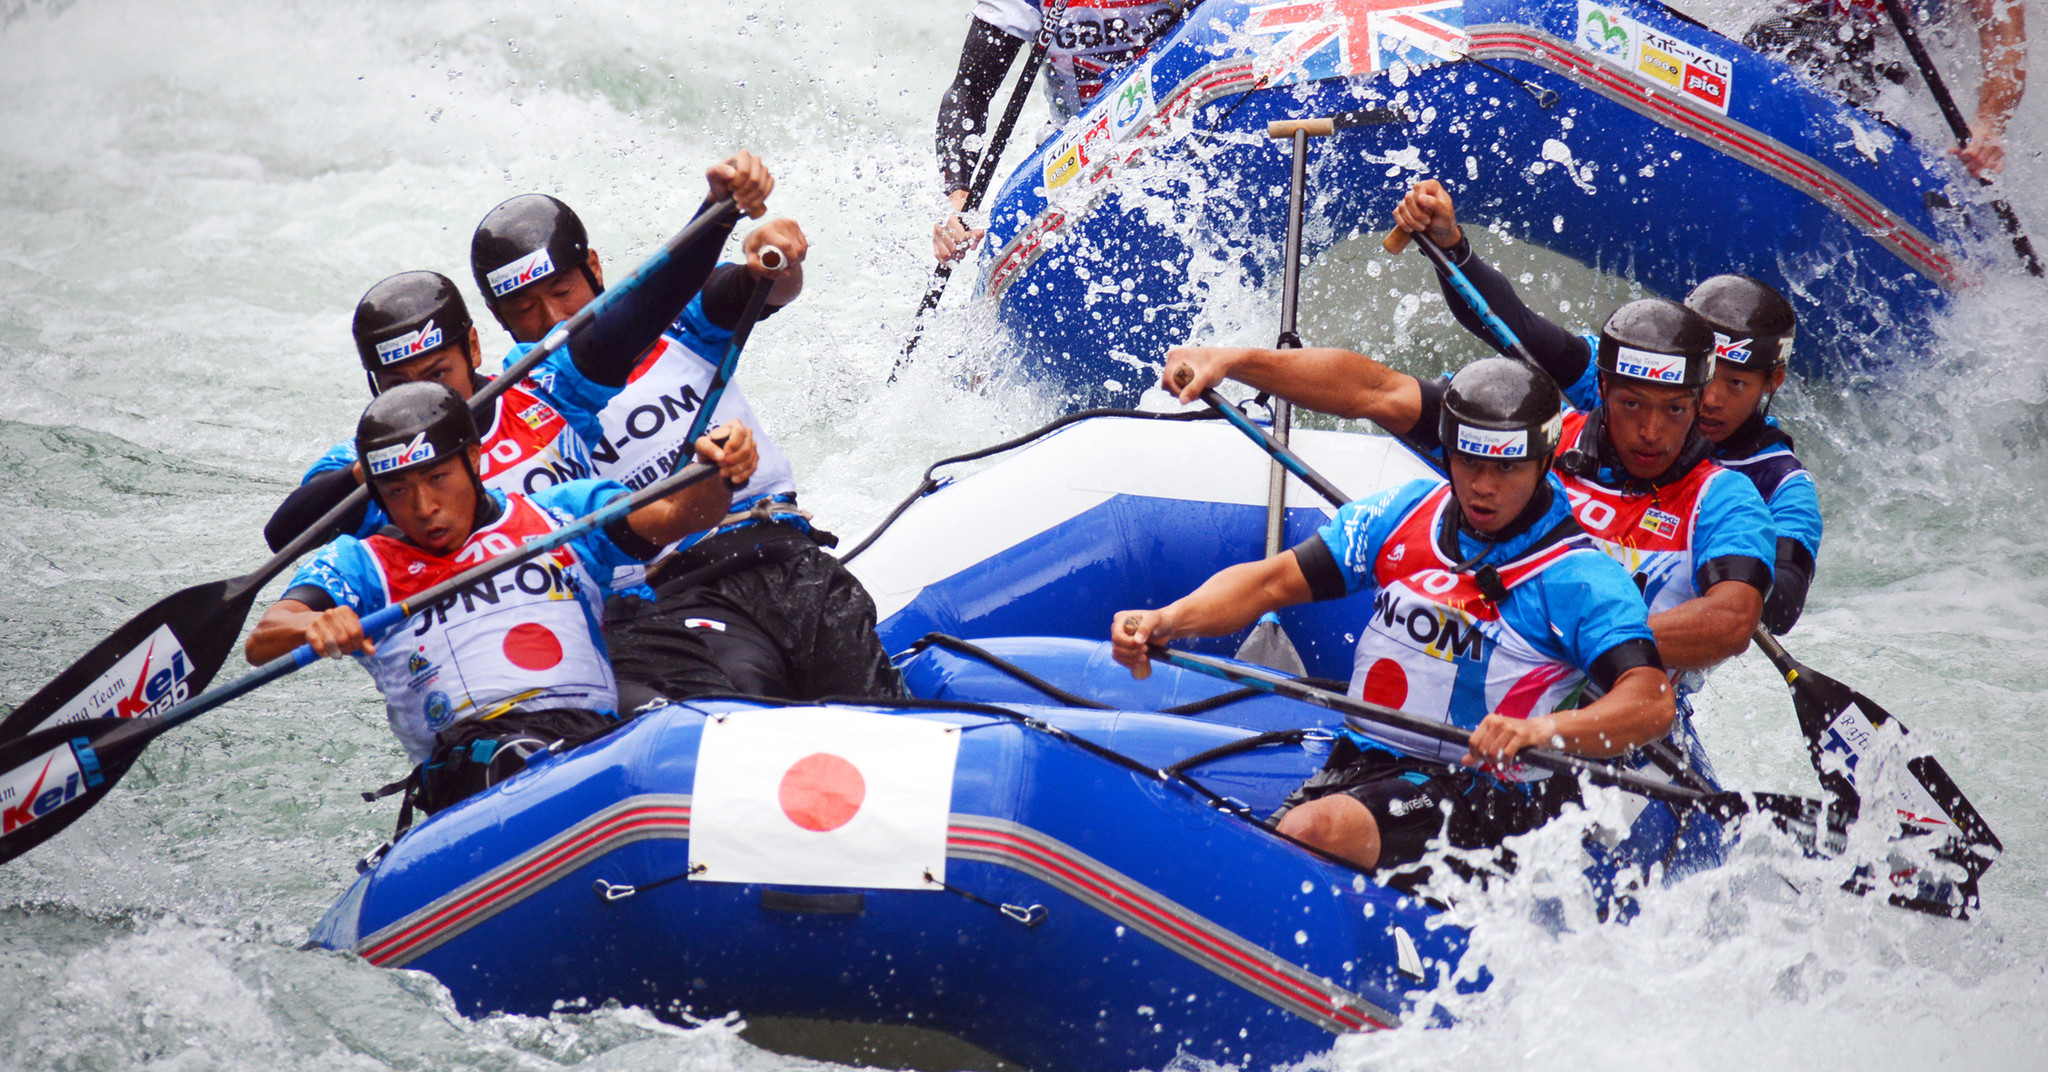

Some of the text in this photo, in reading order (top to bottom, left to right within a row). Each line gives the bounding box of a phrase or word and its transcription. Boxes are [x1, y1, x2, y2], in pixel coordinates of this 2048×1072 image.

[1642, 30, 1729, 78] スポーツくじ
